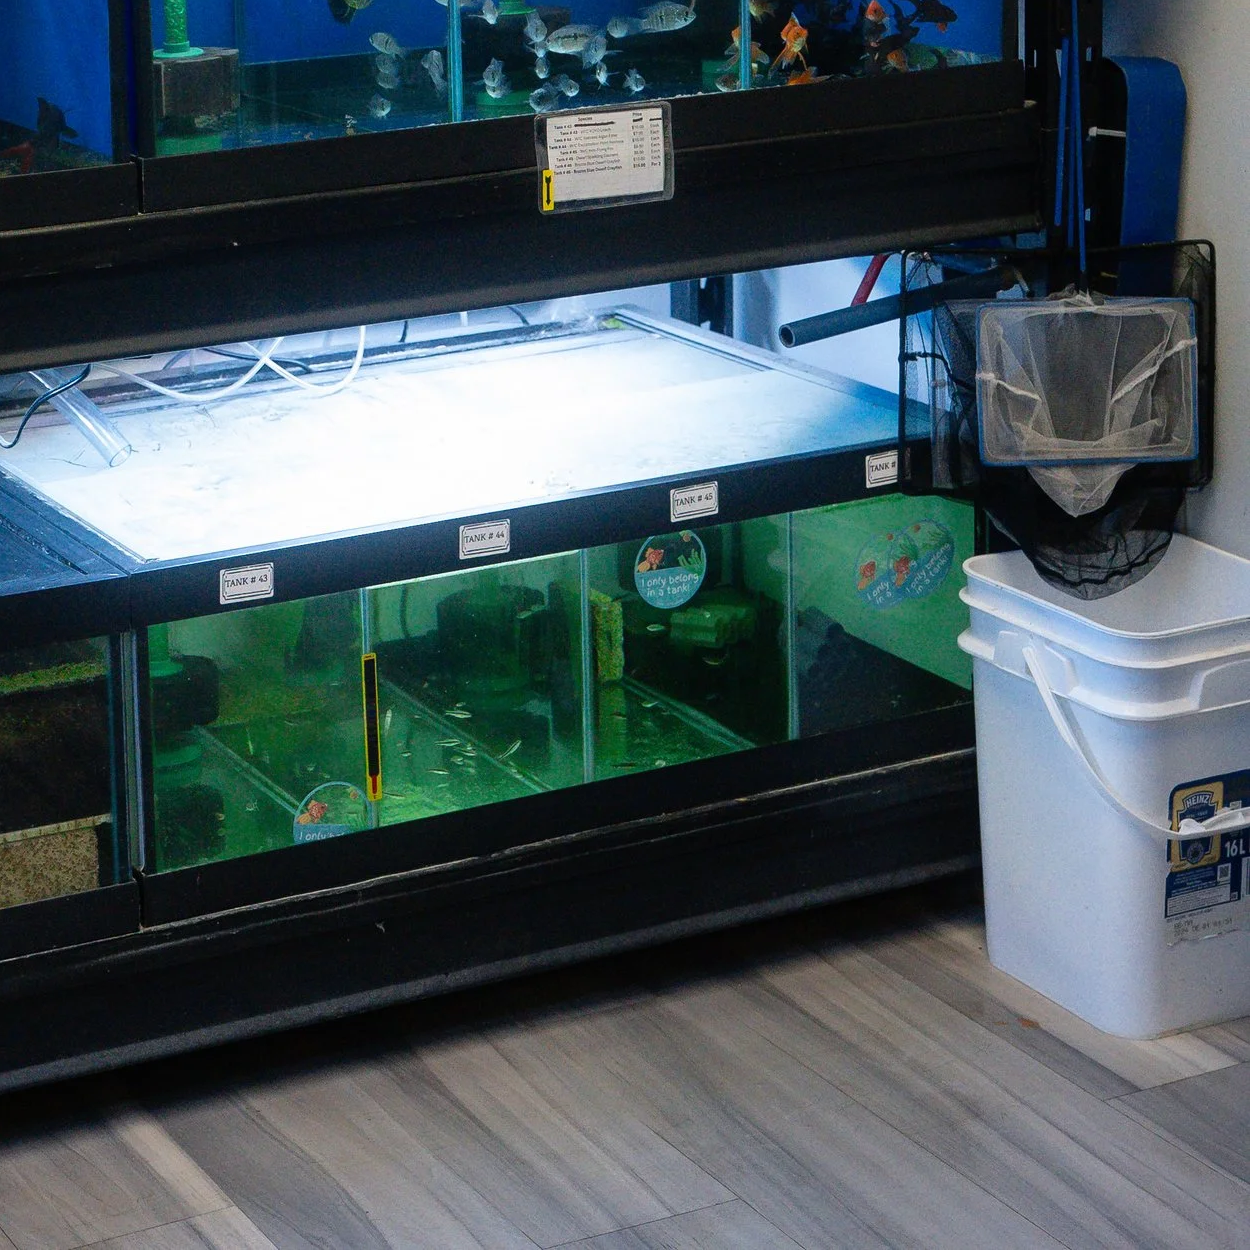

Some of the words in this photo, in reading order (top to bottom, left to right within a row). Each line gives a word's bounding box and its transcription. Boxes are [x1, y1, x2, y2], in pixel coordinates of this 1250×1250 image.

[870, 462, 890, 472] TANK
[674, 497, 696, 506] TANK
[704, 493, 713, 501] 45
[464, 533, 486, 544] TANK
[496, 531, 504, 539] 44
[224, 577, 248, 588] TANK
[250, 576, 256, 584] #
[258, 575, 268, 583] 43
[641, 579, 644, 587] I
[647, 576, 666, 588] only
[668, 573, 699, 584] belong
[647, 587, 655, 597] in
[658, 588, 664, 596] a
[668, 583, 690, 595] tank!
[1186, 795, 1210, 808] HEINZ
